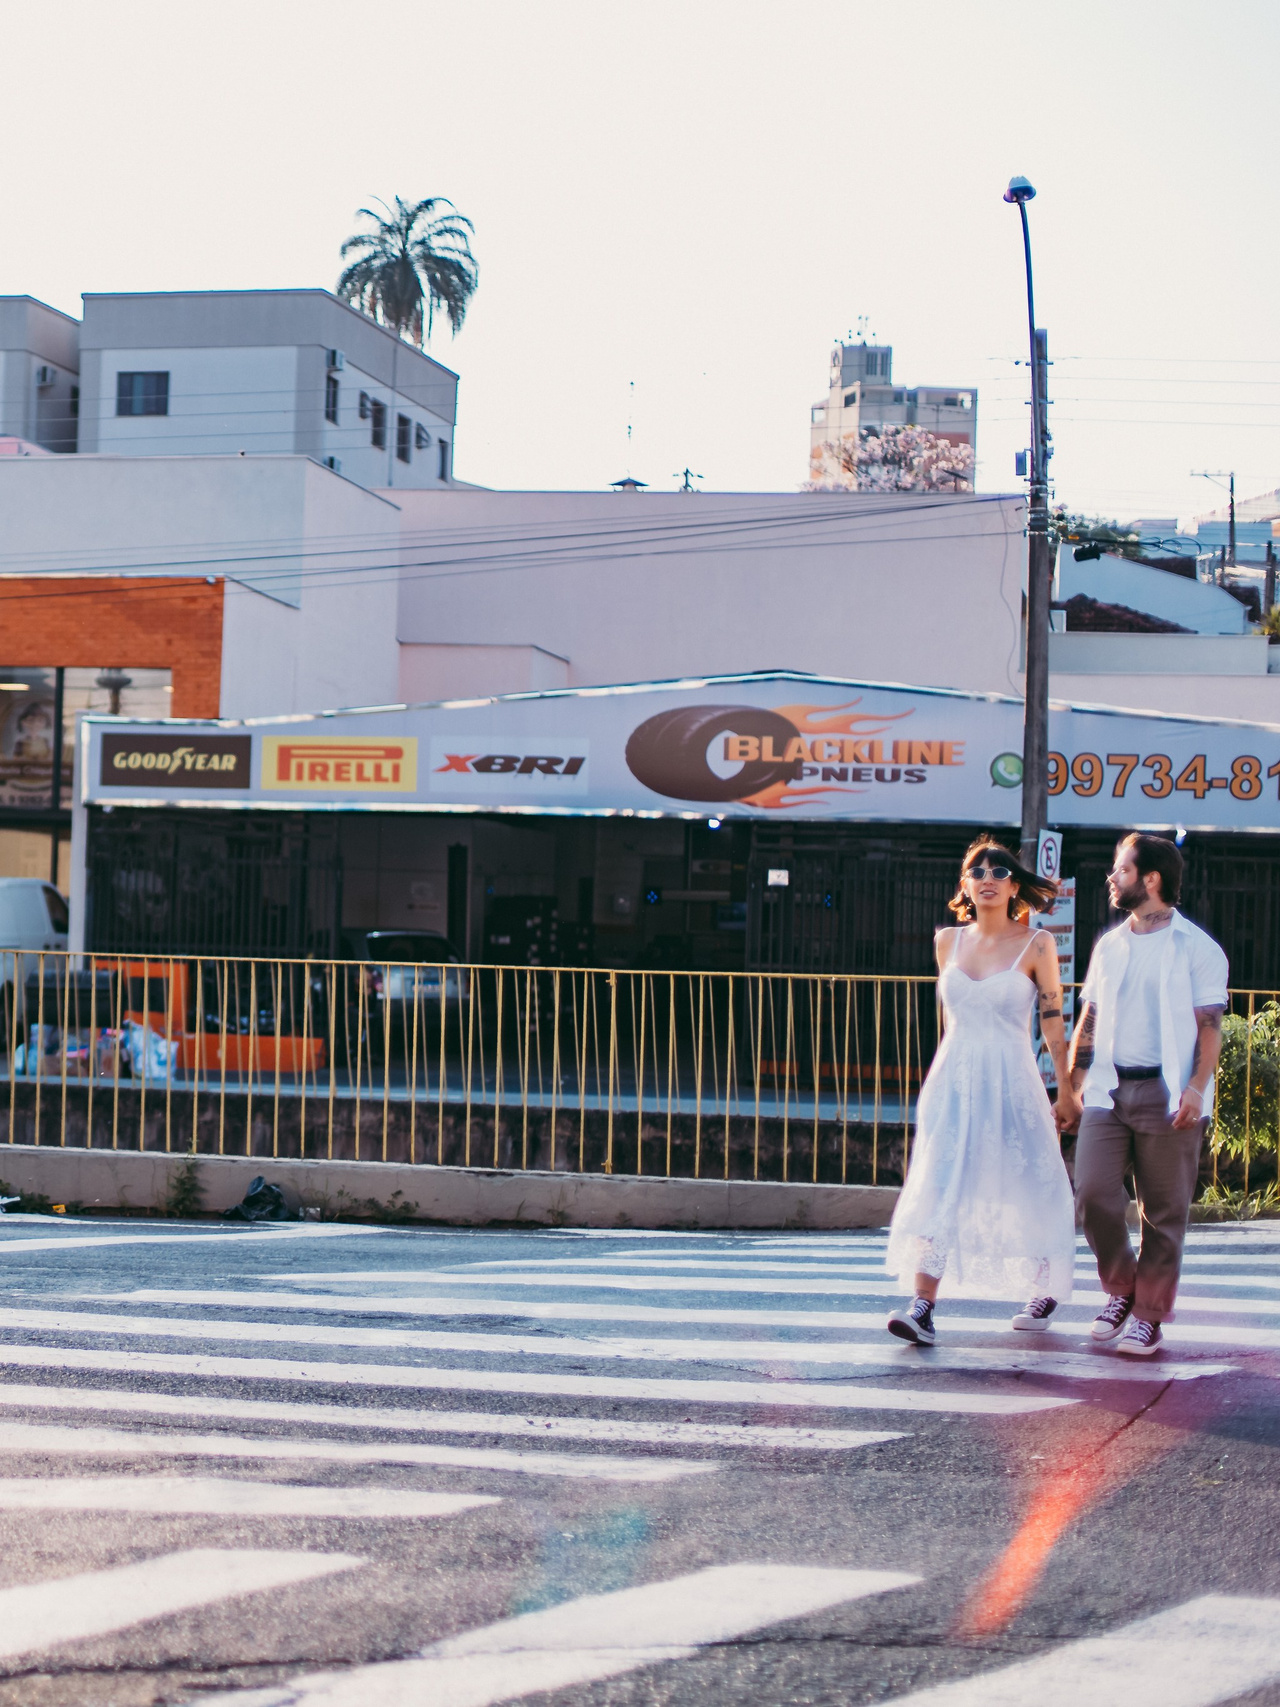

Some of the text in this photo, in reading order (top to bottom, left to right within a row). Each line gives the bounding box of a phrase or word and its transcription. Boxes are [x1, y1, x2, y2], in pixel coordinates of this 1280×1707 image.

[113, 747, 237, 775] GOODYEAR
[277, 744, 404, 783] PIRELLI
[432, 753, 586, 775] XBRI
[724, 735, 967, 766] BLACKLINE
[795, 766, 927, 785] PNEUS
